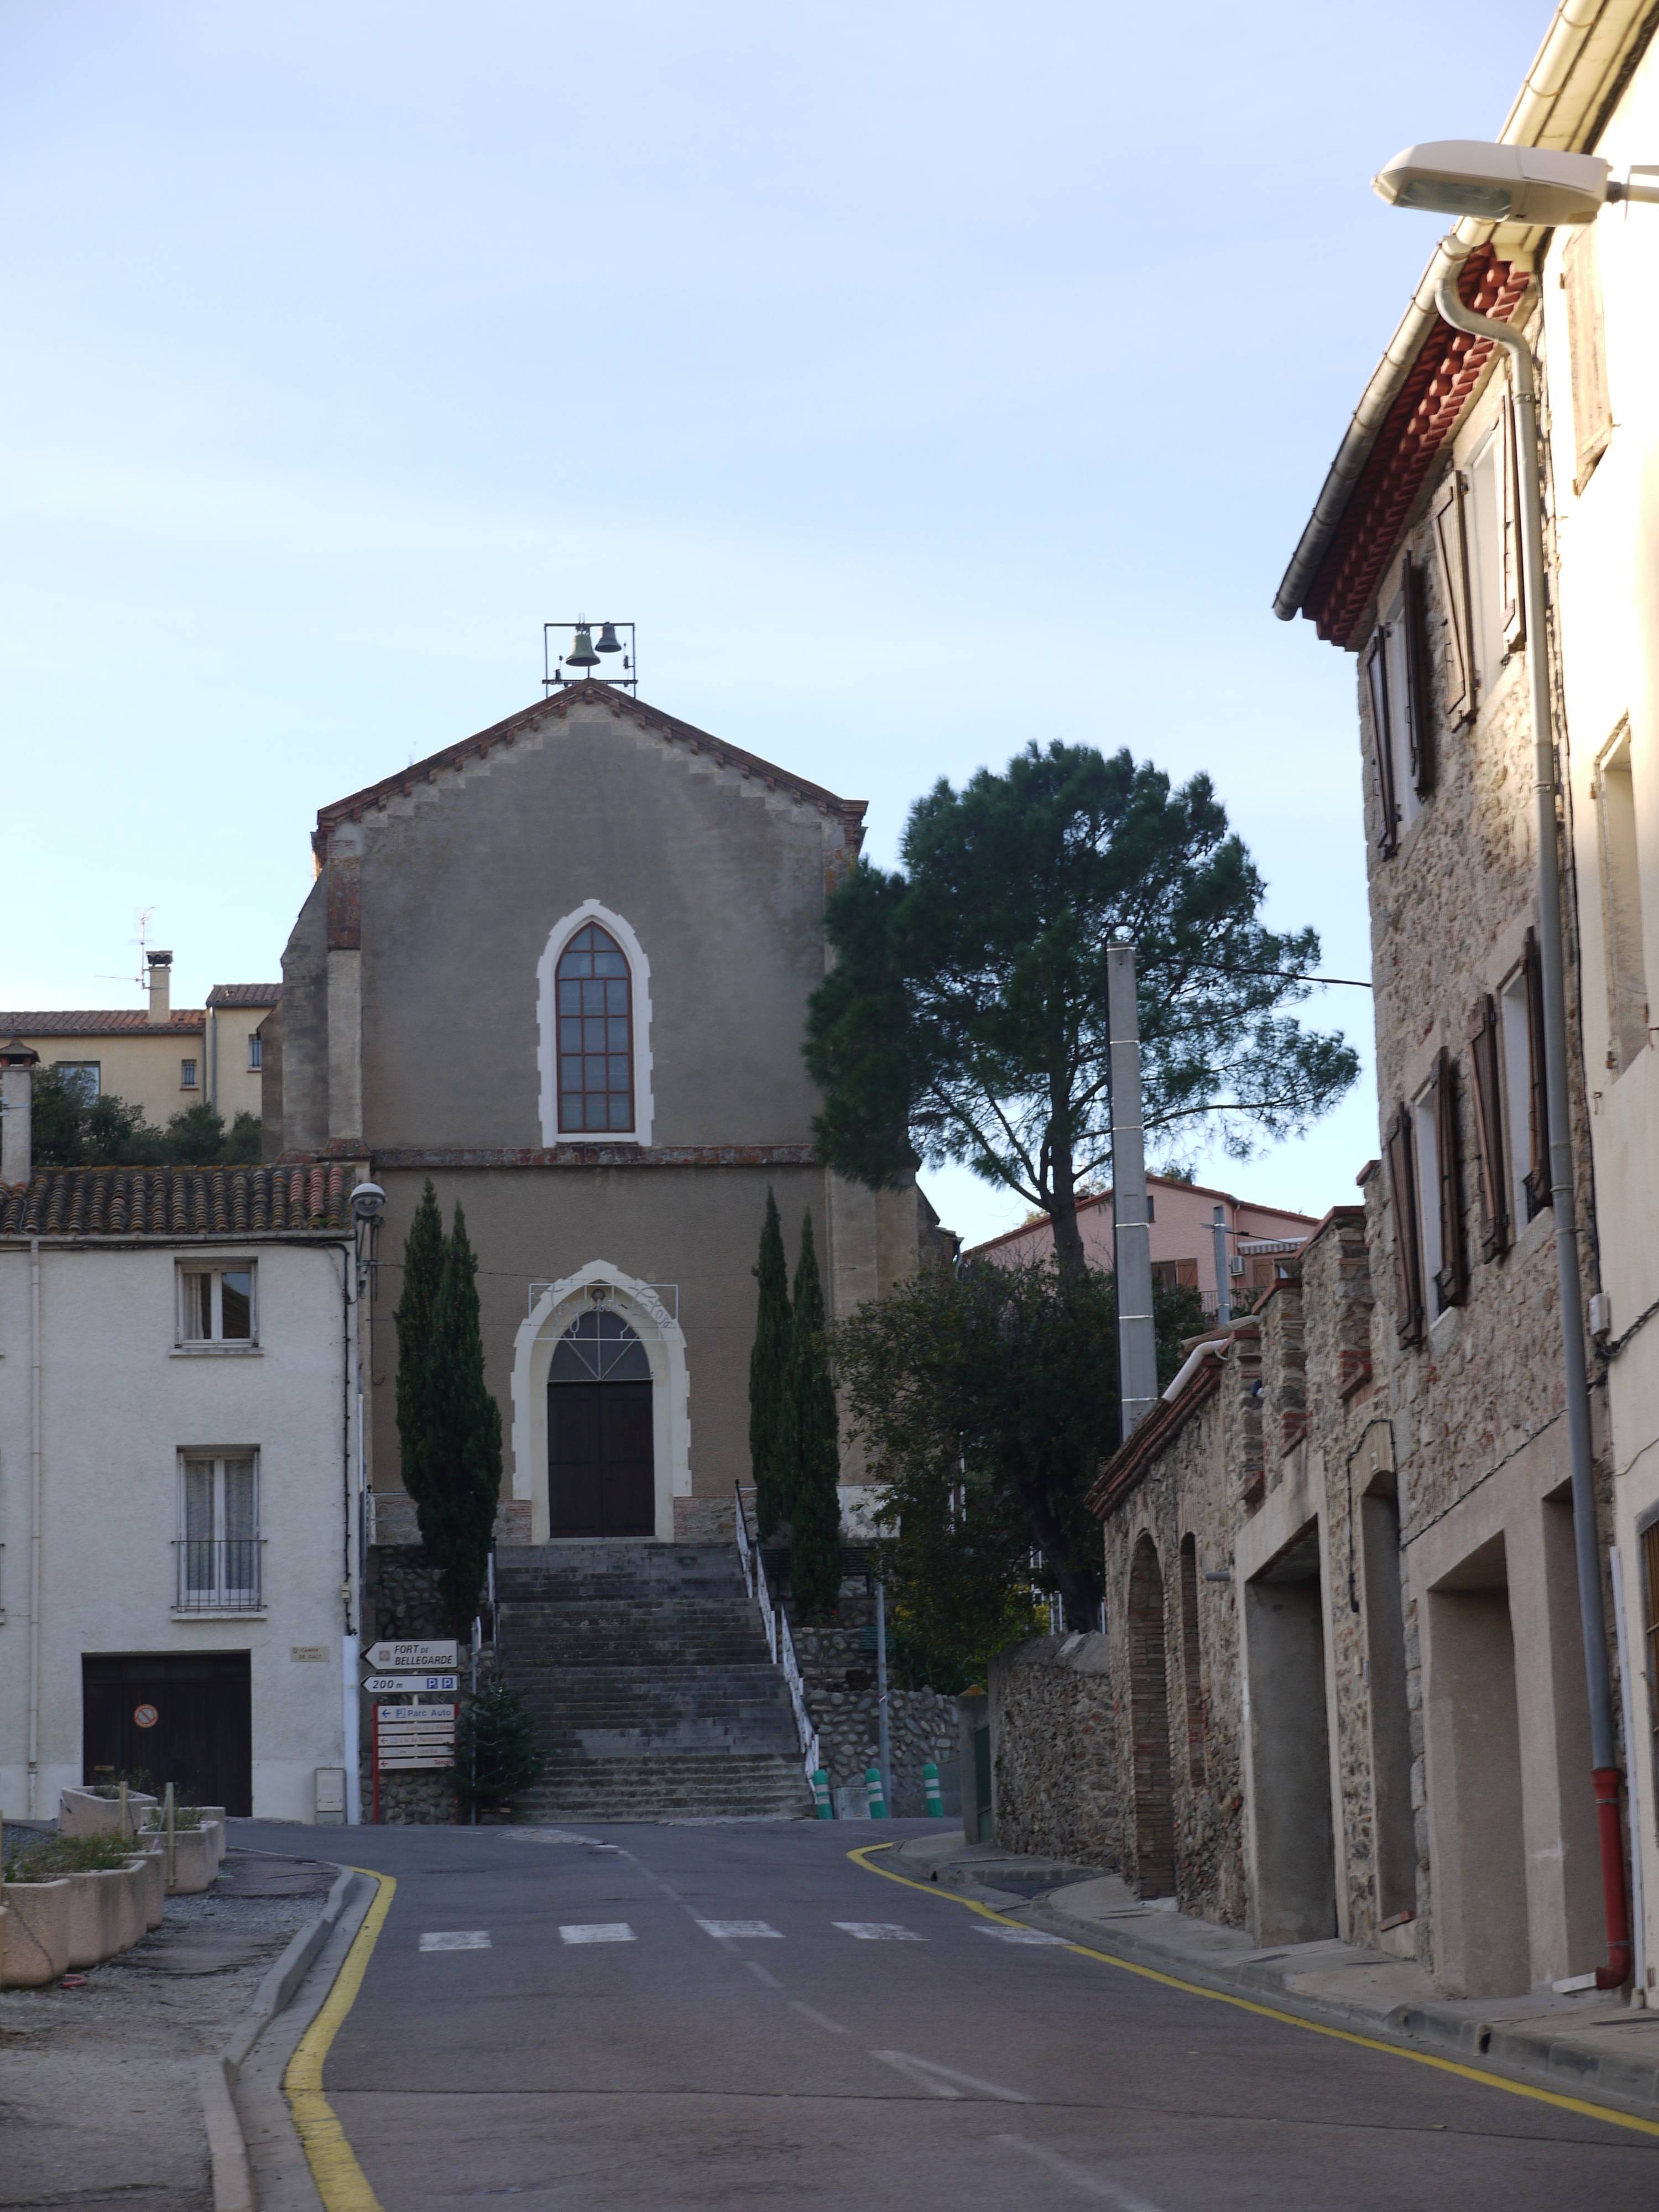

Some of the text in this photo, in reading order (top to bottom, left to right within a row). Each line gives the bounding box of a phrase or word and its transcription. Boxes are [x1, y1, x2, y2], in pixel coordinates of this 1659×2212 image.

[394, 1645, 419, 1653] FORT
[394, 1655, 453, 1666] BELLEGARDE
[373, 1680, 394, 1689] 200
